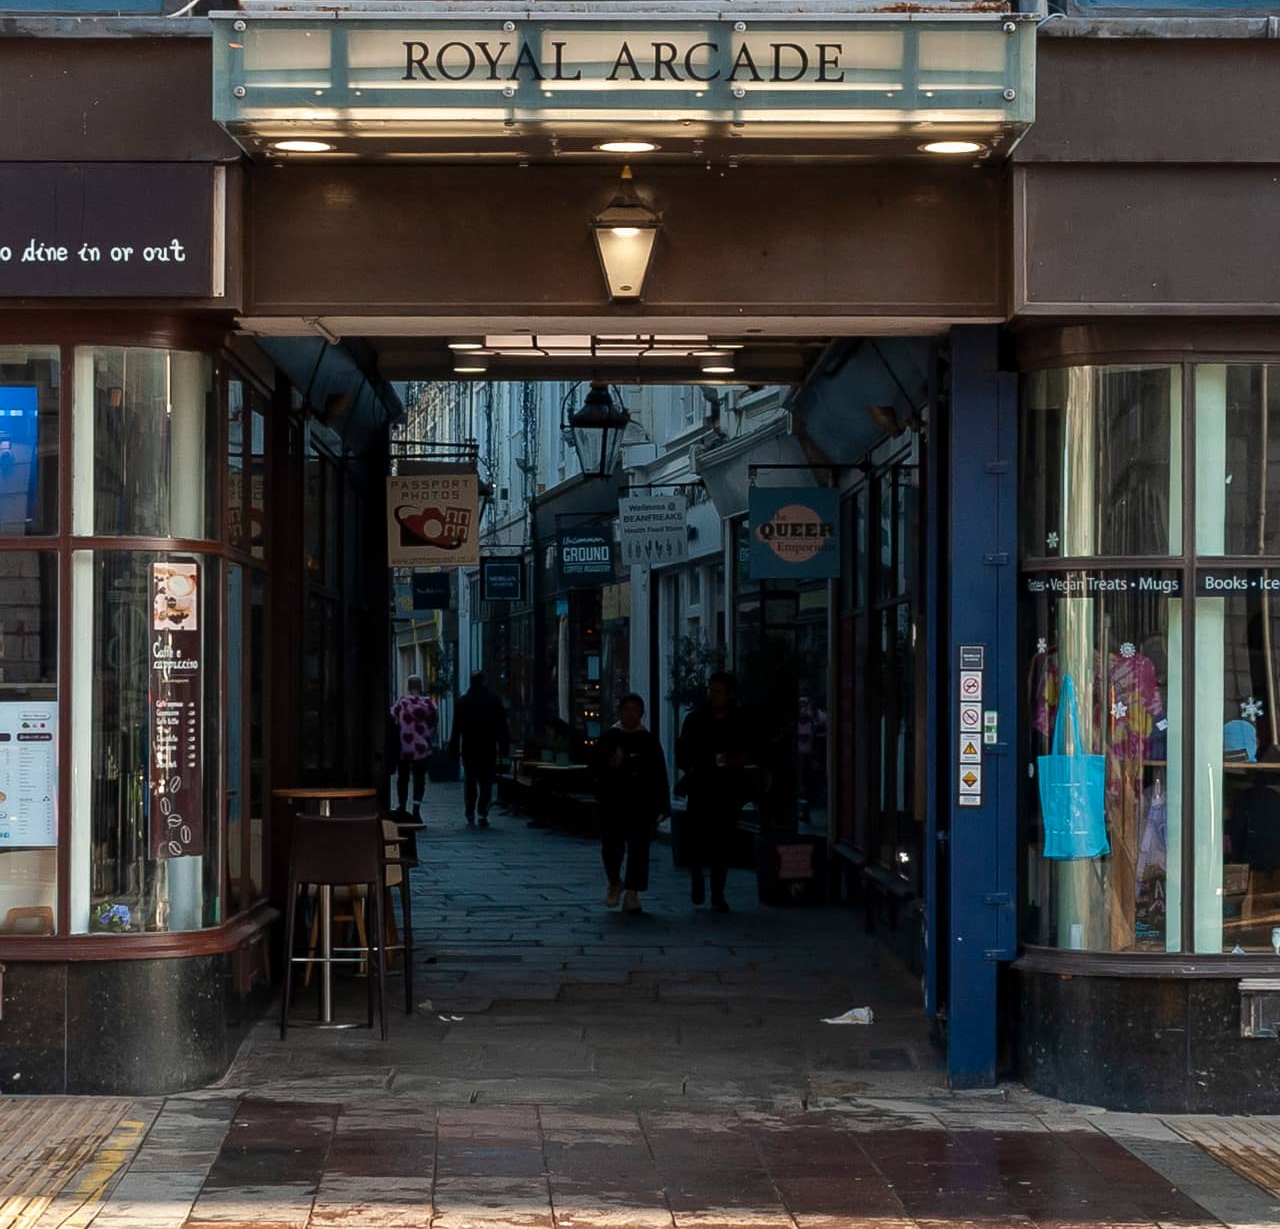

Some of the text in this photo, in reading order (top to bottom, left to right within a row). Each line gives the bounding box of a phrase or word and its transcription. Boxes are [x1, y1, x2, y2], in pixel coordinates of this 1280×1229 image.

[401, 41, 846, 83] ROYAL ARCADE
[21, 238, 68, 262] dine
[77, 243, 101, 262] in
[110, 246, 134, 262] or
[143, 238, 186, 262] out
[391, 479, 469, 490] PASSPORT
[401, 491, 460, 500] PHOTOS
[759, 522, 834, 539] QUEER
[563, 546, 610, 562] GROUND
[776, 540, 835, 554] Emporium
[1050, 578, 1084, 594] Vegan
[1087, 577, 1128, 591] Treats
[1139, 577, 1180, 594] Mugs
[1204, 577, 1249, 591] Books
